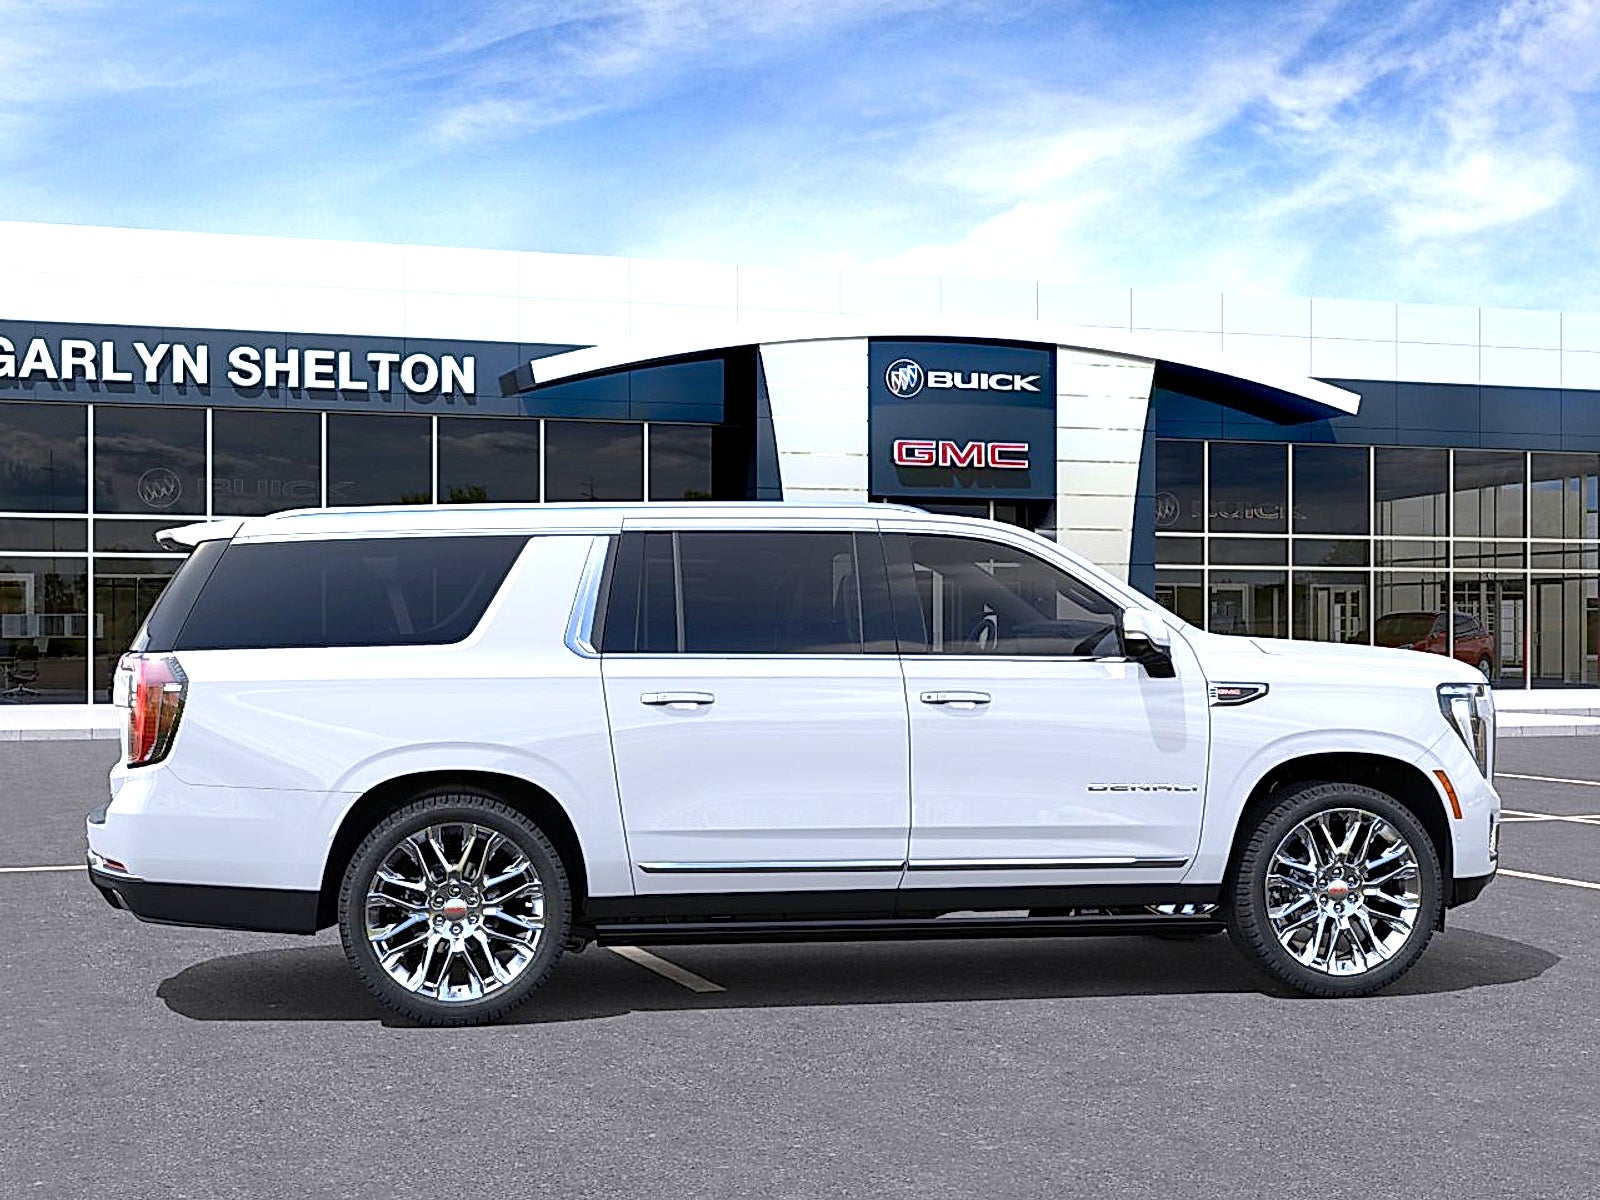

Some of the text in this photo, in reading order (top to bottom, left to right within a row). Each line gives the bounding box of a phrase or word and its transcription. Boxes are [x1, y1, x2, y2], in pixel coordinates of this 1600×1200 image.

[228, 346, 476, 394] SHELTON
[927, 371, 1041, 392] BUICK
[893, 439, 1029, 468] GMC
[1087, 782, 1198, 791] DENALI
